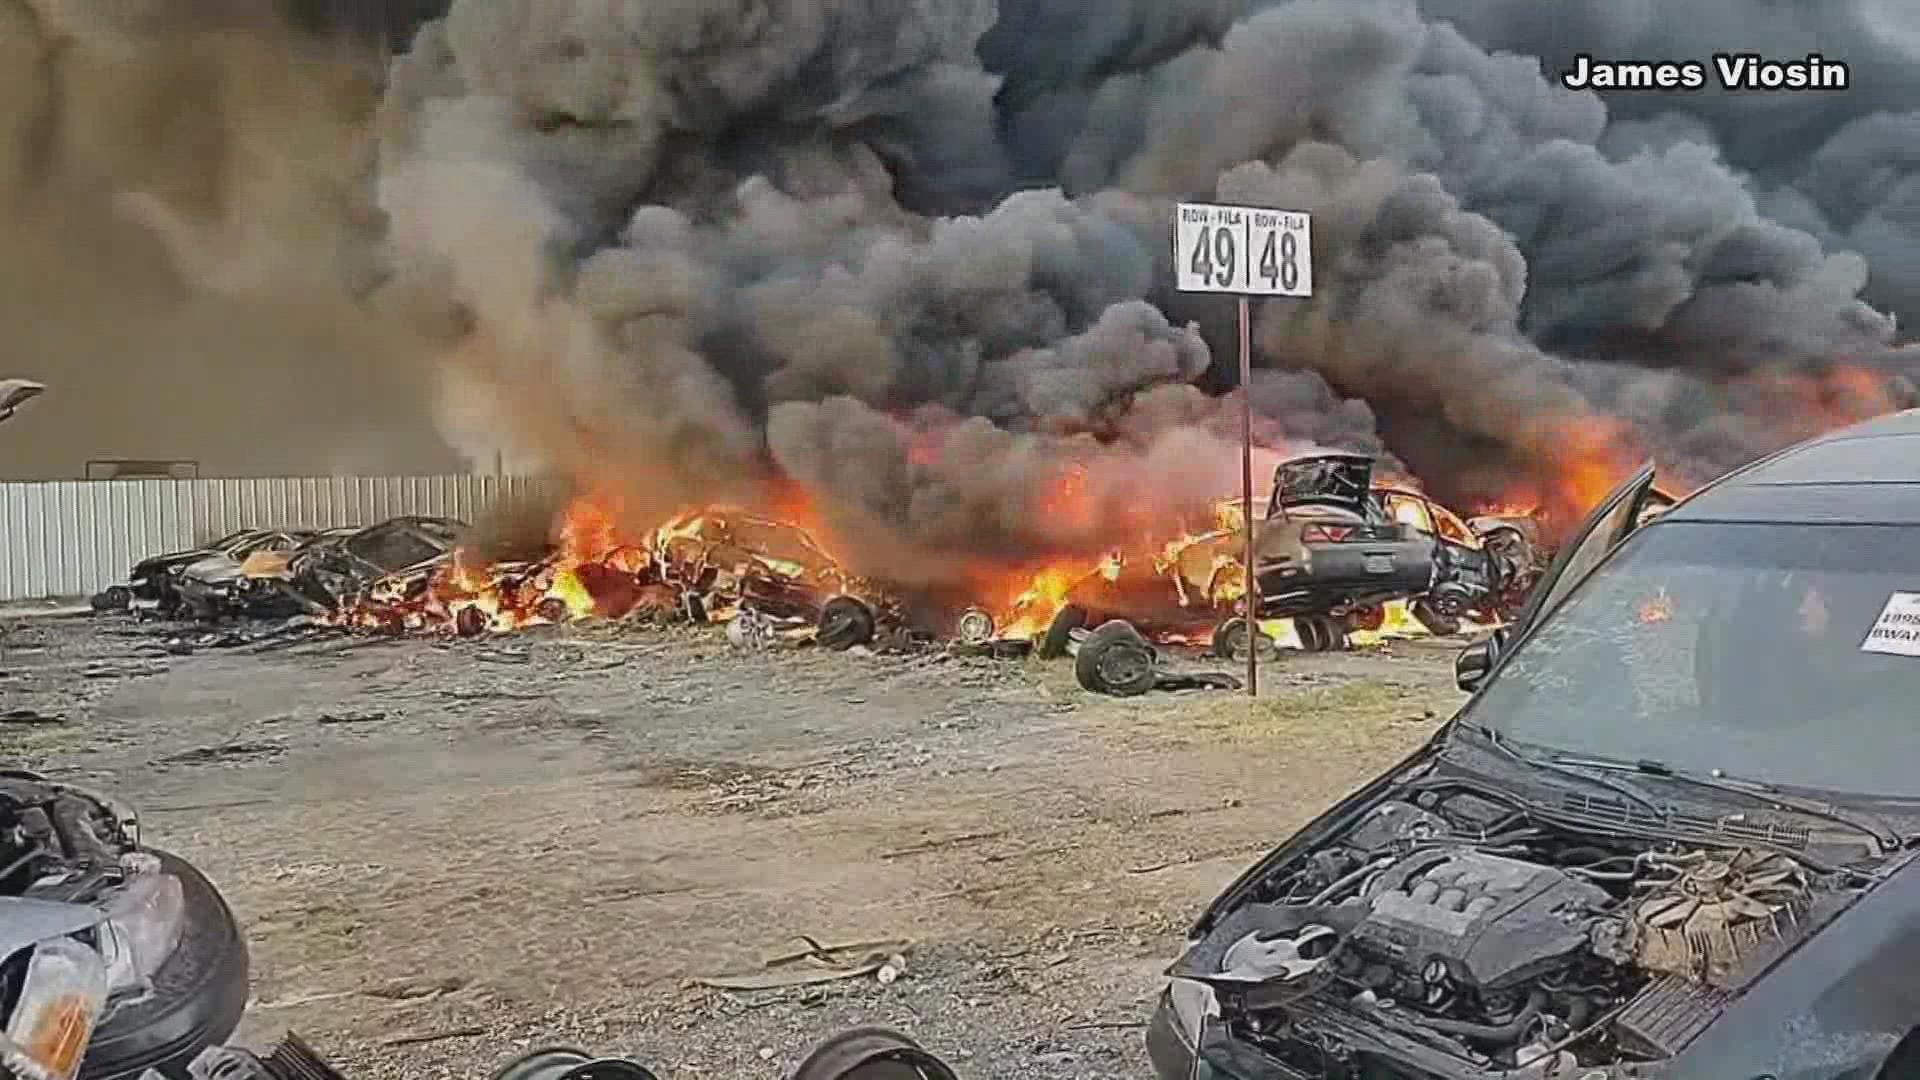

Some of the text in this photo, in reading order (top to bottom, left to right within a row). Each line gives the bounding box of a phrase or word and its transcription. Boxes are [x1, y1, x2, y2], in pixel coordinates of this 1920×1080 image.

[1183, 208, 1208, 223] ROW
[1218, 209, 1242, 225] FILA
[1255, 213, 1277, 228] ROW
[1284, 216, 1305, 231] FILA
[1191, 226, 1235, 287] 49
[1260, 230, 1298, 291] 48
